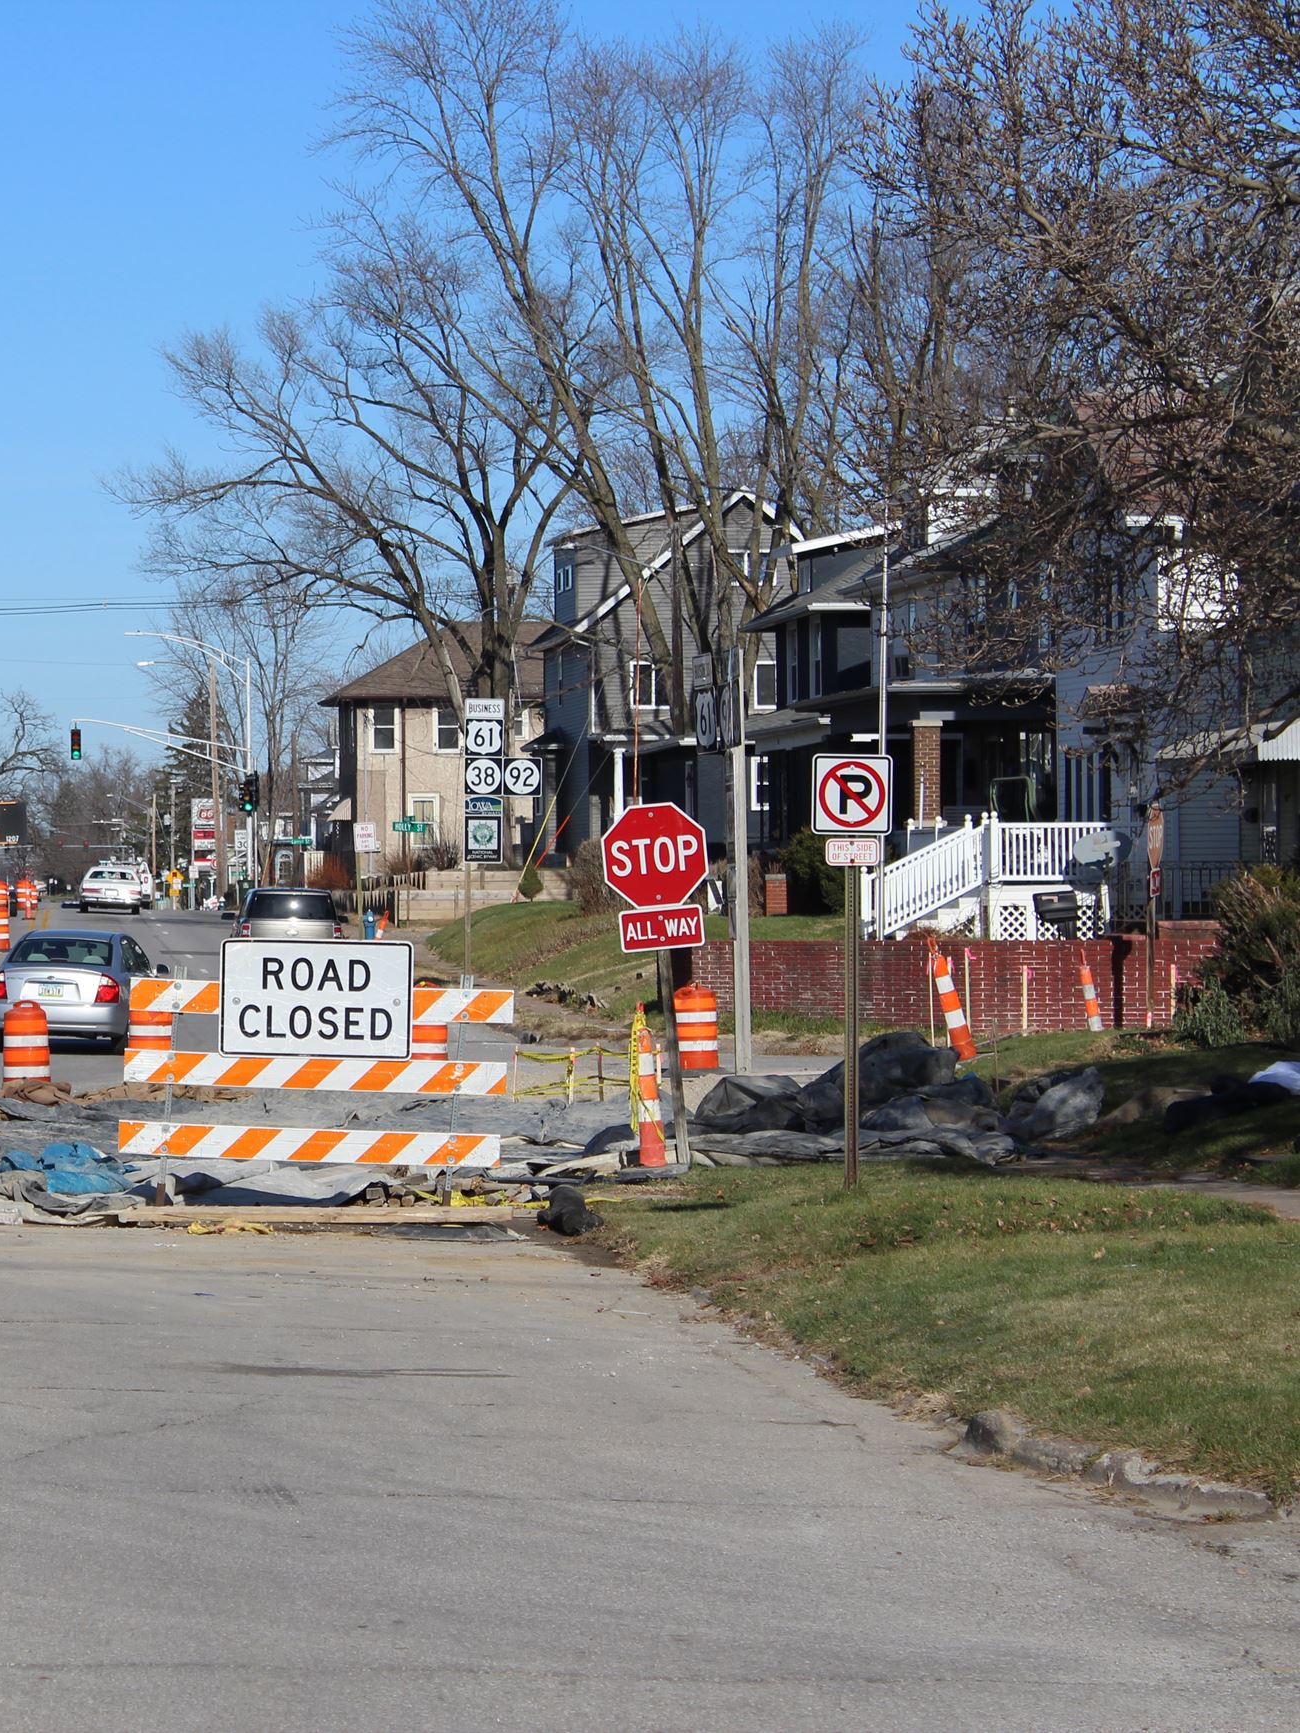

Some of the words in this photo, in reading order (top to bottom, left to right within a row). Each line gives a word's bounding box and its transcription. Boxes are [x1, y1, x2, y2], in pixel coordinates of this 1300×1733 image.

[468, 703, 500, 713] BUSINESS
[700, 701, 711, 736] 61
[474, 727, 493, 747] 61
[471, 766, 495, 787] 38
[509, 766, 534, 787] 92
[394, 822, 411, 831] HOLLY
[417, 824, 423, 832] ST
[1149, 825, 1163, 849] STOP
[611, 834, 698, 877] STOP
[832, 843, 850, 851] THIS
[856, 843, 873, 851] SIDE
[843, 852, 873, 861] STREET
[626, 921, 658, 942] ALL
[664, 916, 698, 938] WAY
[261, 957, 371, 992] ROAD
[238, 1004, 393, 1041] CLOSED
